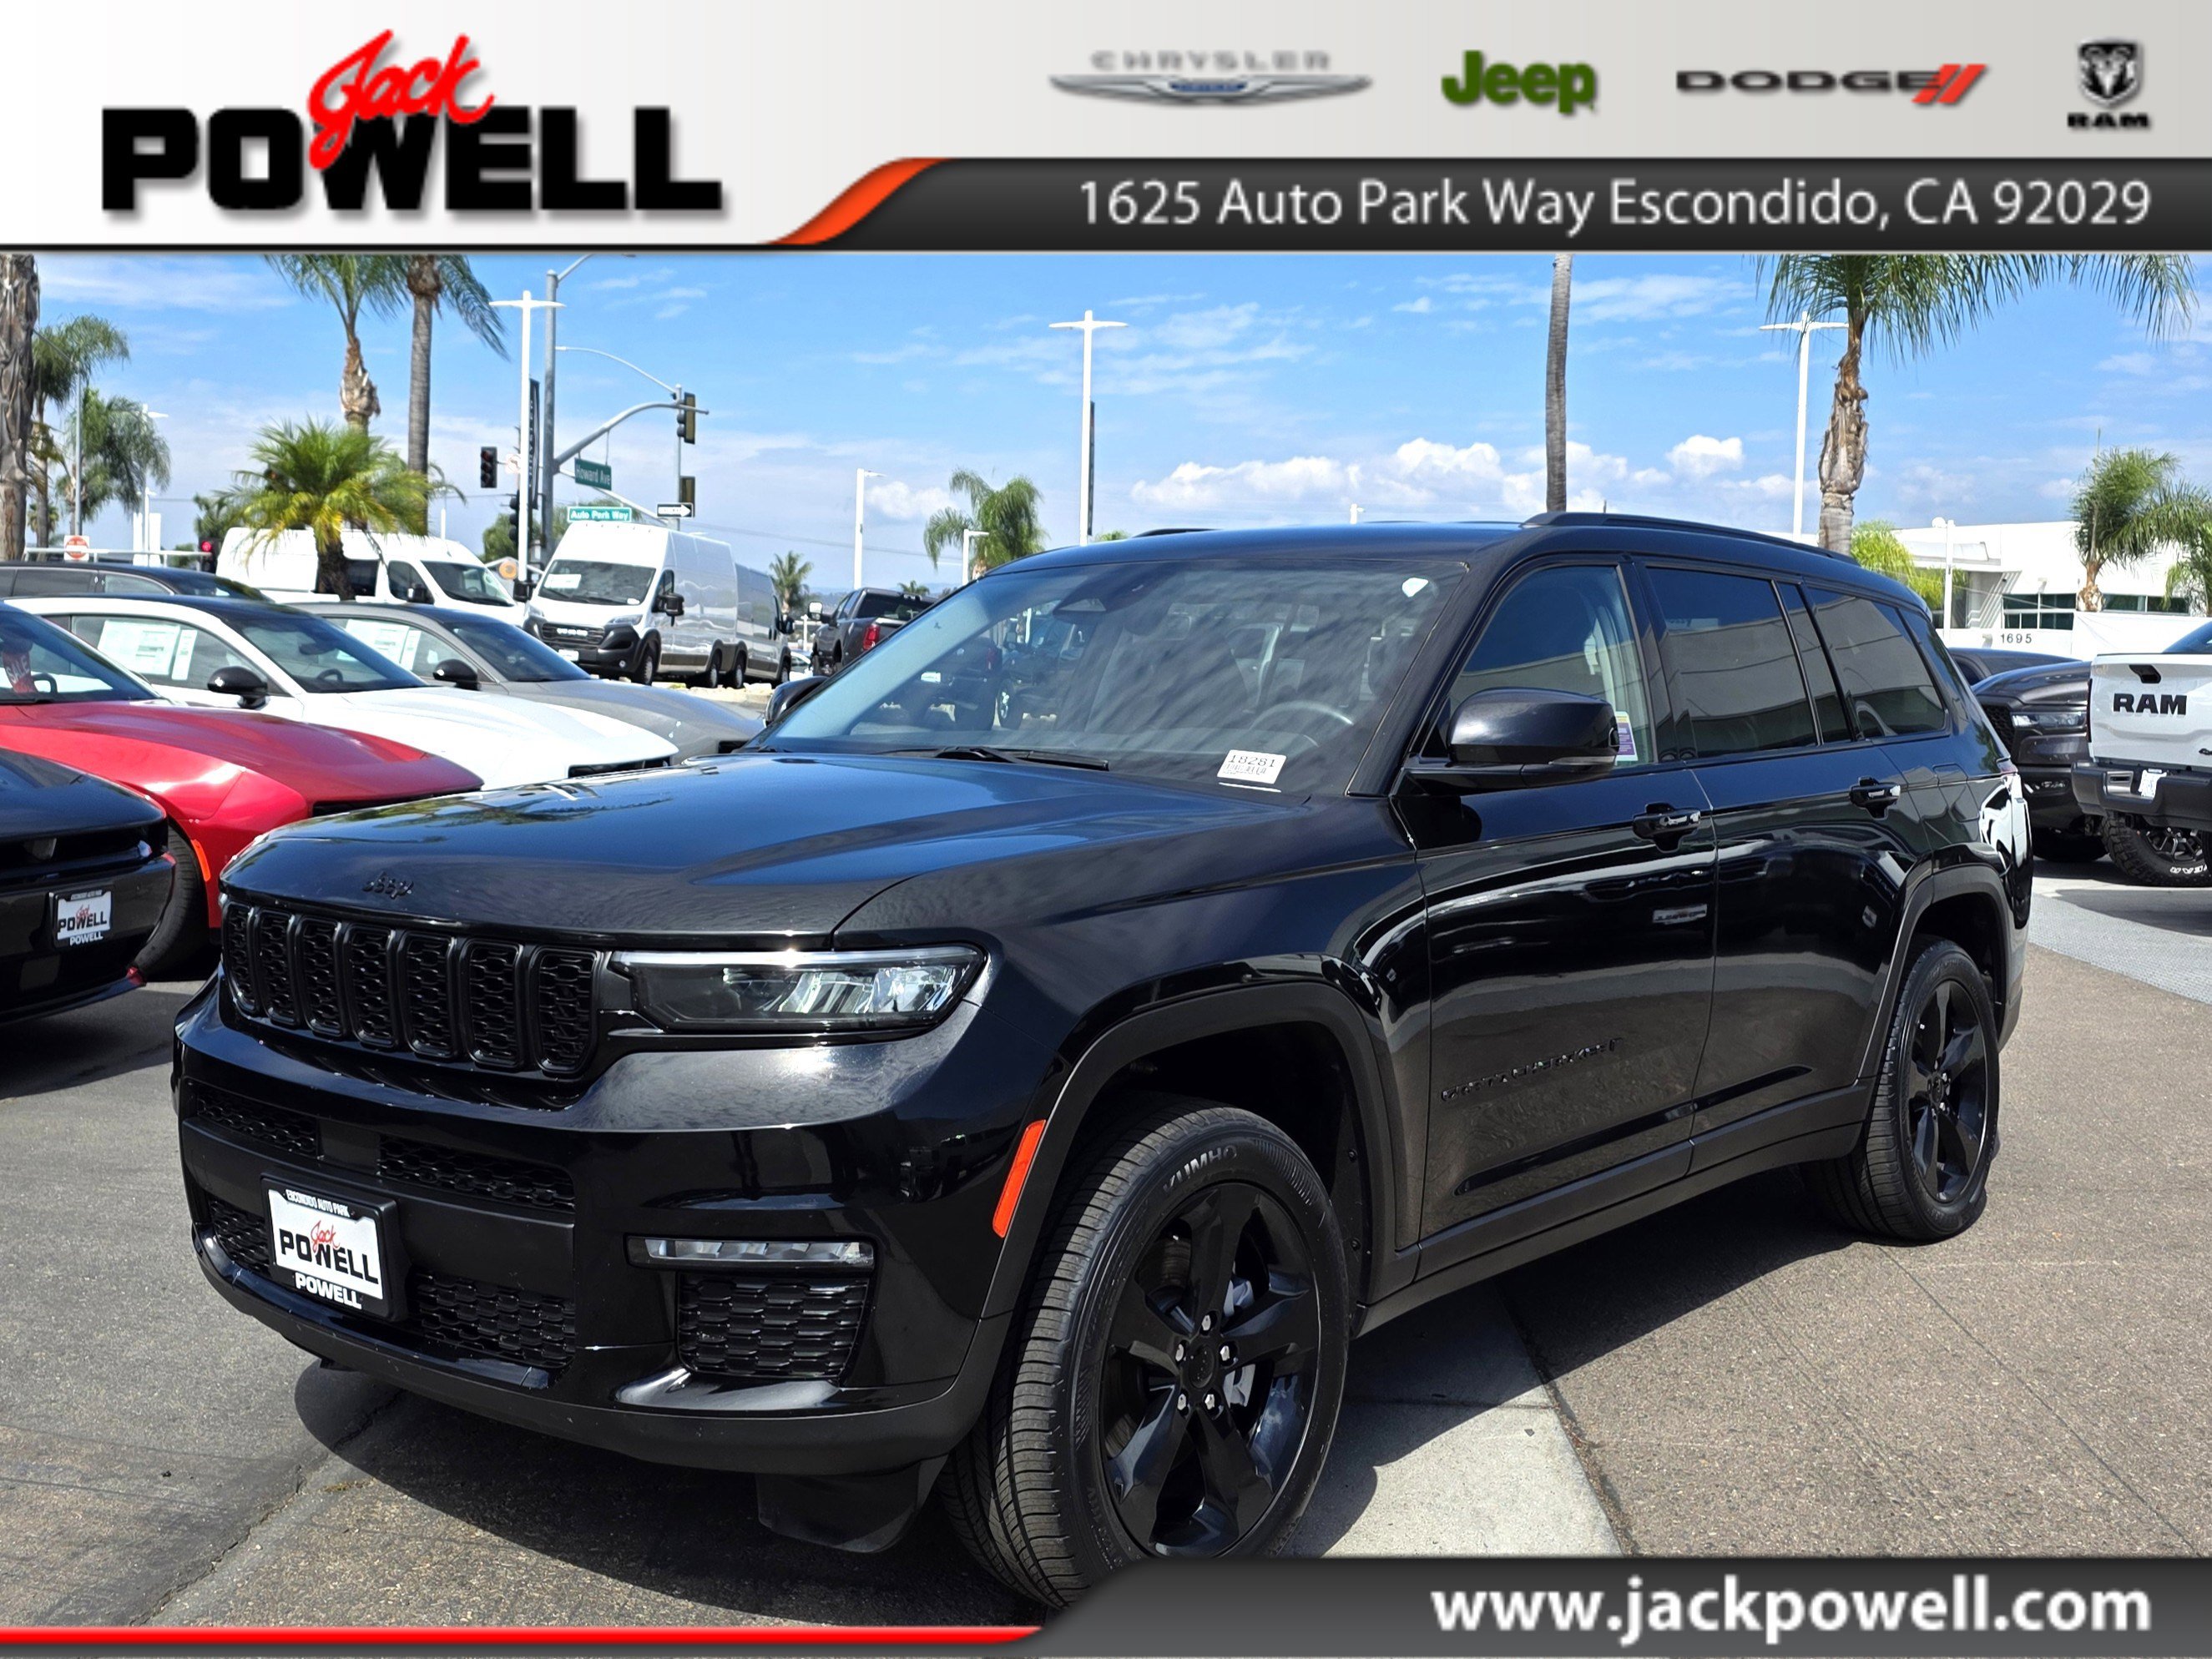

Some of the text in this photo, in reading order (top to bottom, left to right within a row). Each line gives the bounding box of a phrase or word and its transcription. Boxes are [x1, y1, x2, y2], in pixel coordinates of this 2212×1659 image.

[576, 464, 610, 485] Howard Ave
[571, 510, 629, 521] Auto Park Way
[2000, 633, 2032, 643] 1695
[2114, 693, 2187, 715] RAM
[1228, 754, 1275, 768] 18281
[58, 910, 107, 933] POWELL
[69, 930, 104, 946] POWELL
[311, 1220, 341, 1253] Jack
[279, 1228, 379, 1285] POWELL
[295, 1272, 362, 1310] POWELL
